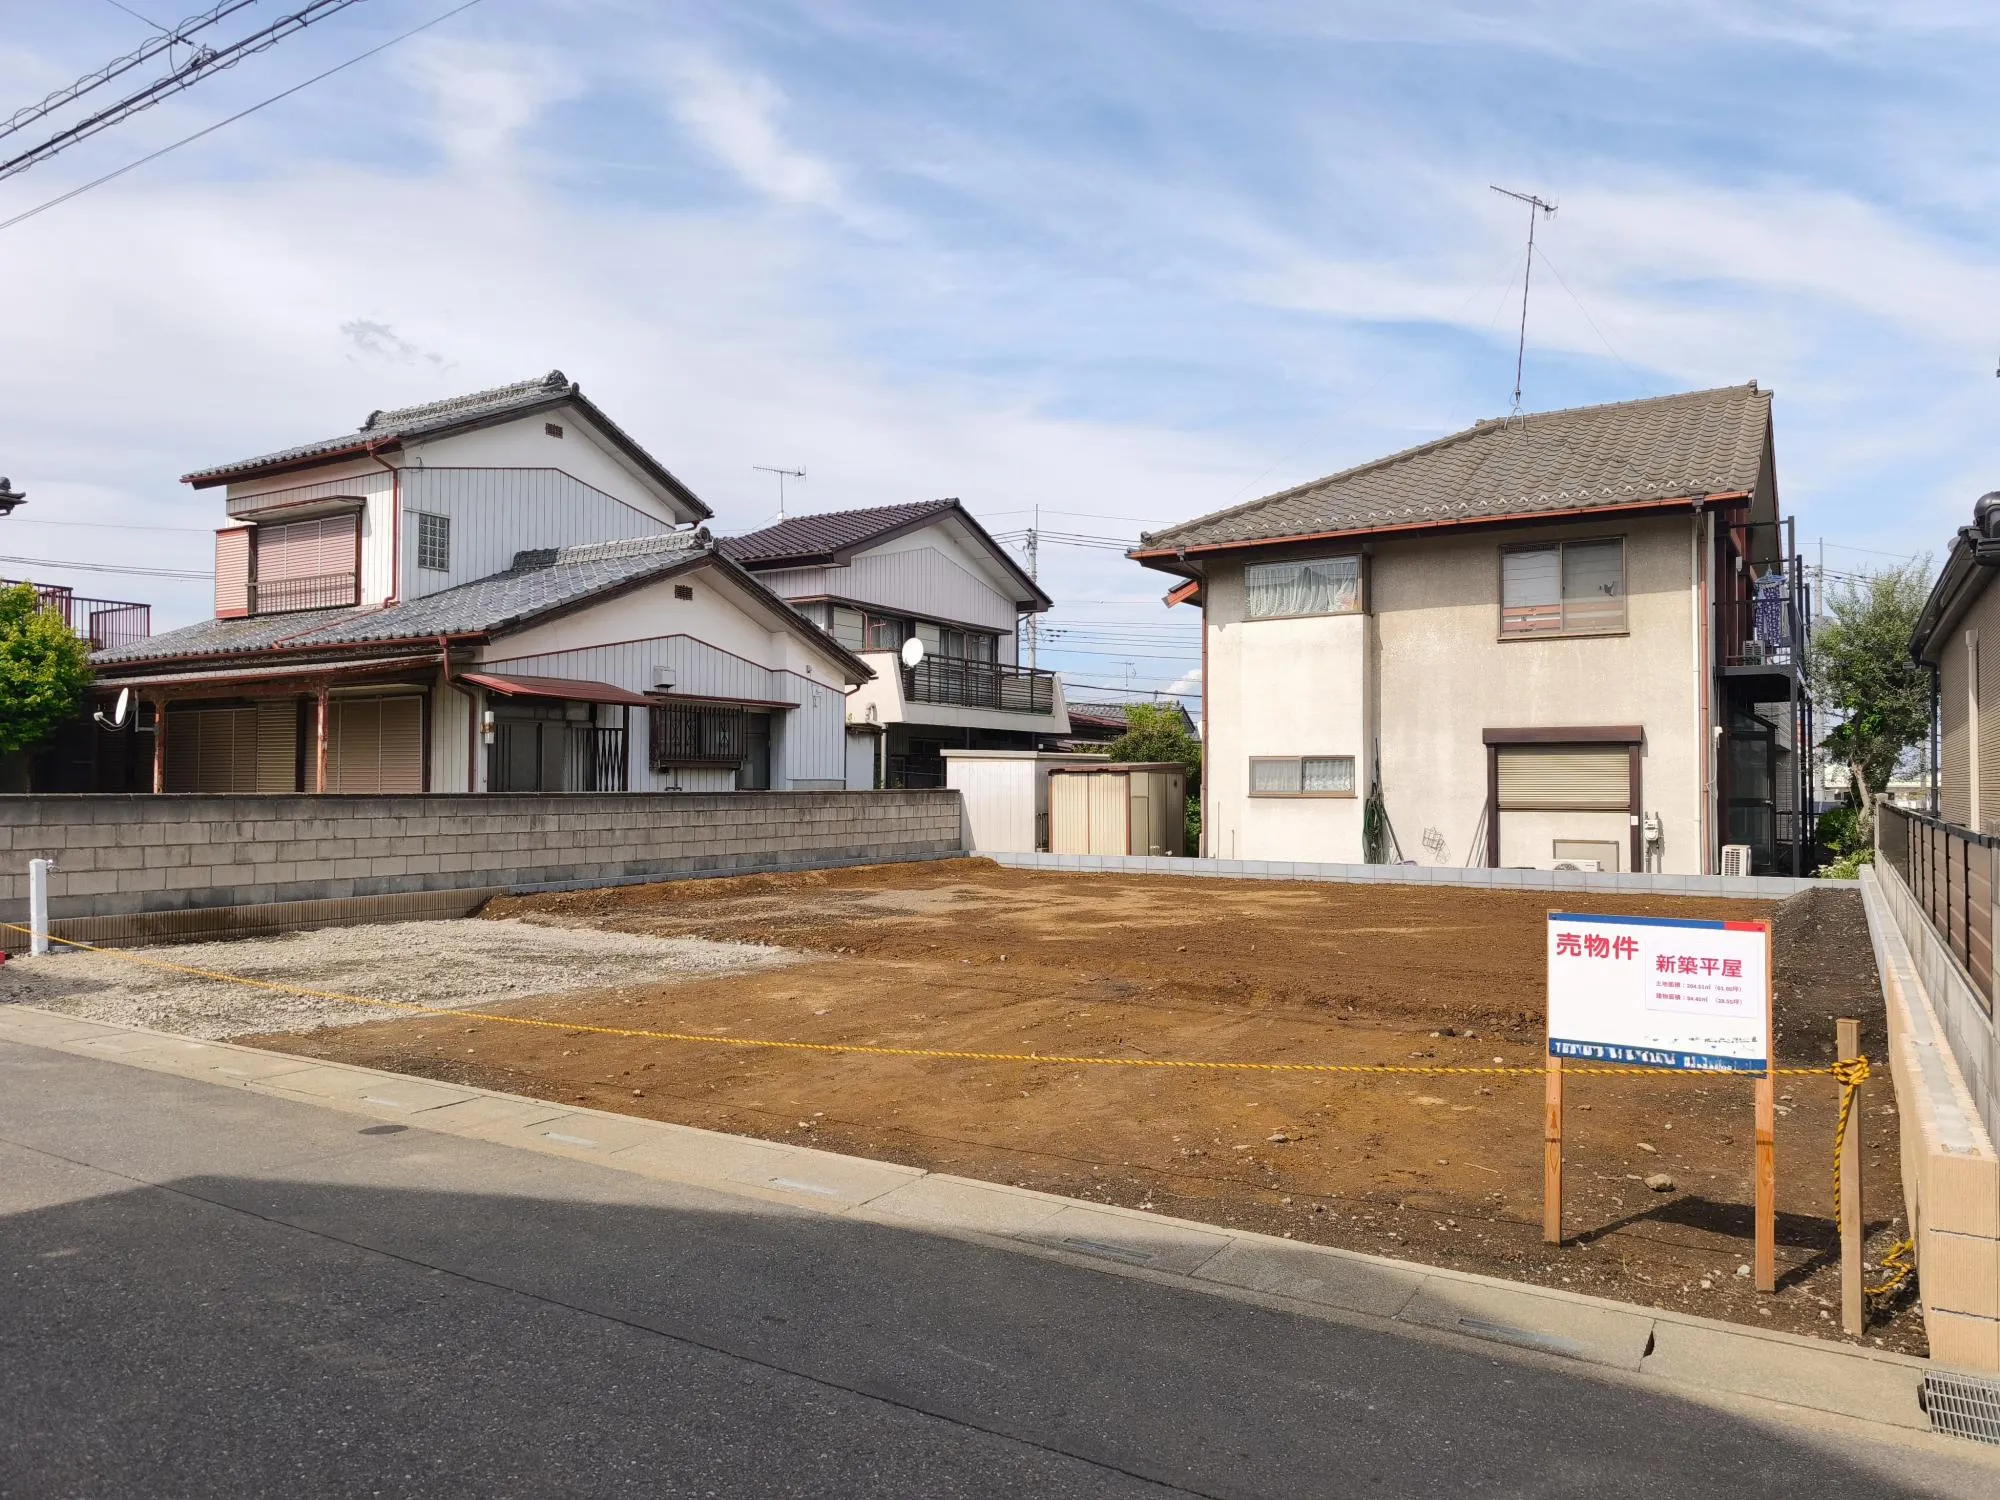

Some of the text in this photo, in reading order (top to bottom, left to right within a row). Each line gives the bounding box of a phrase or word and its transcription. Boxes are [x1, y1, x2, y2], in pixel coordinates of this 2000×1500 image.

[1556, 932, 1640, 961] 売物件
[1655, 953, 1743, 979] 新築平屋
